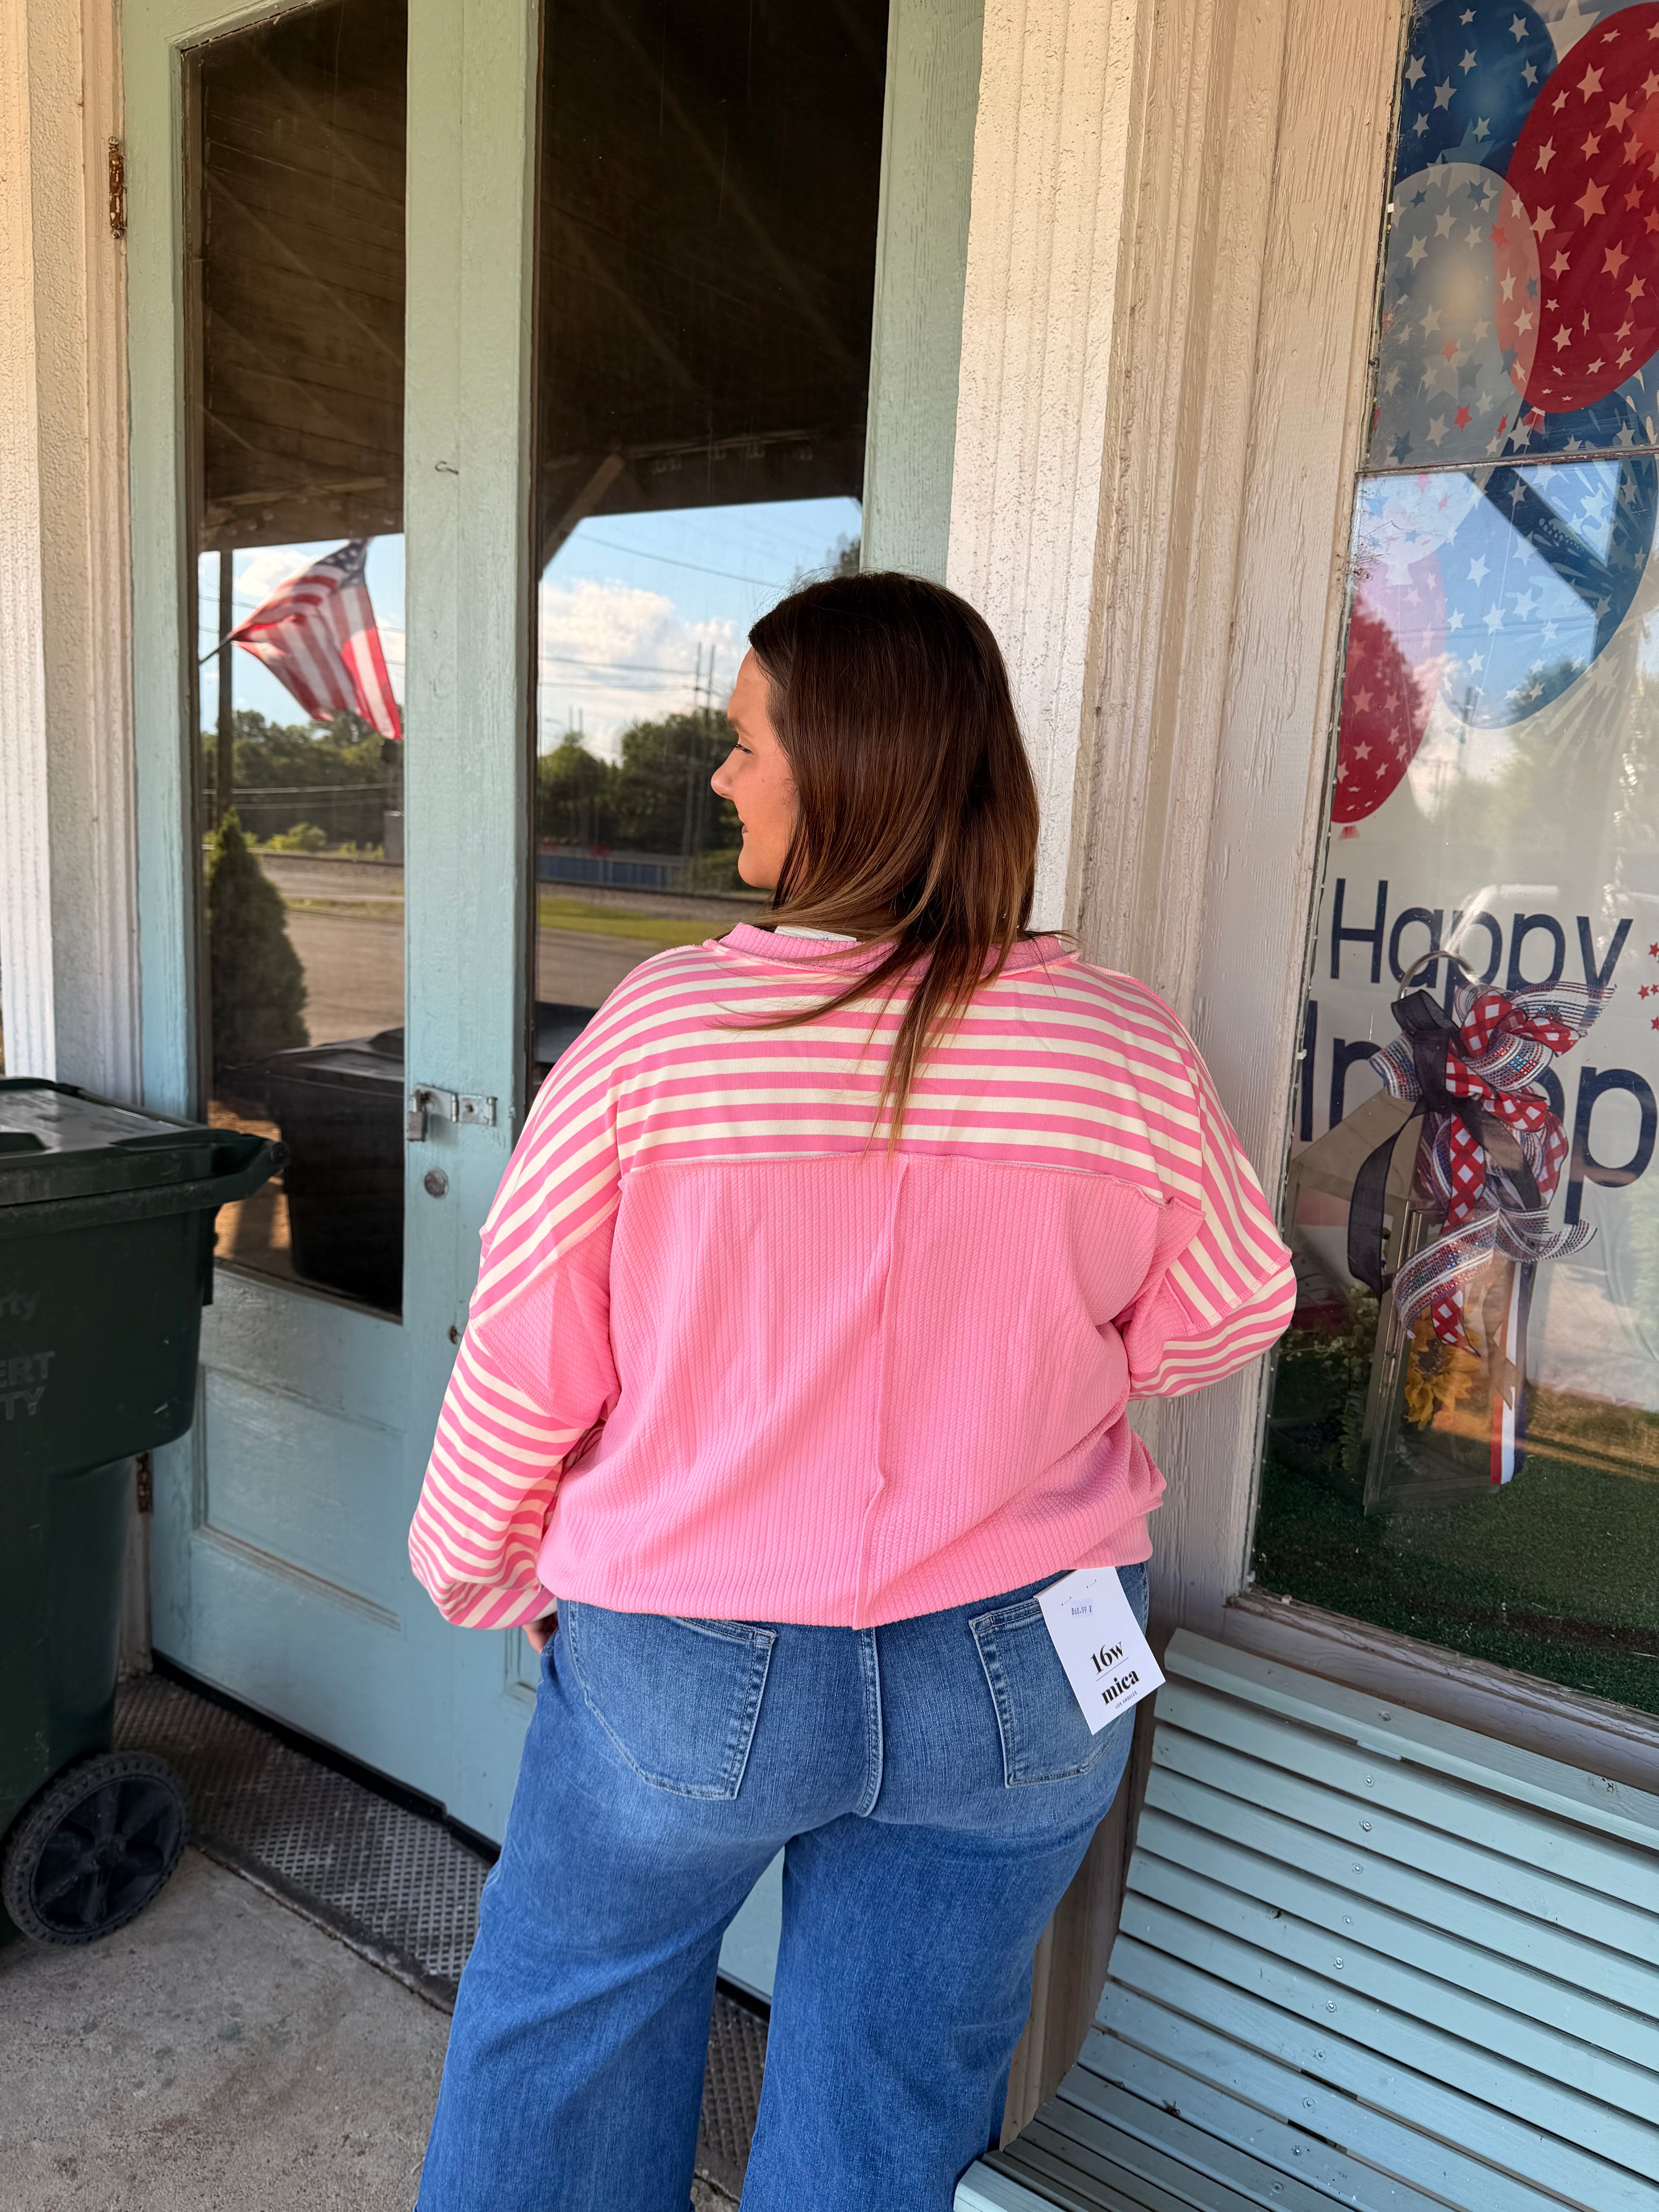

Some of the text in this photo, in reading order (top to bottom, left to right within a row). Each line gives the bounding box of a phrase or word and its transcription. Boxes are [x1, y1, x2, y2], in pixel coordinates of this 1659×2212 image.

[1330, 878, 1634, 1030] Happy
[1071, 1606, 1087, 1615] $68.99
[1090, 1641, 1124, 1675] 16w
[1101, 1670, 1140, 1705] mica
